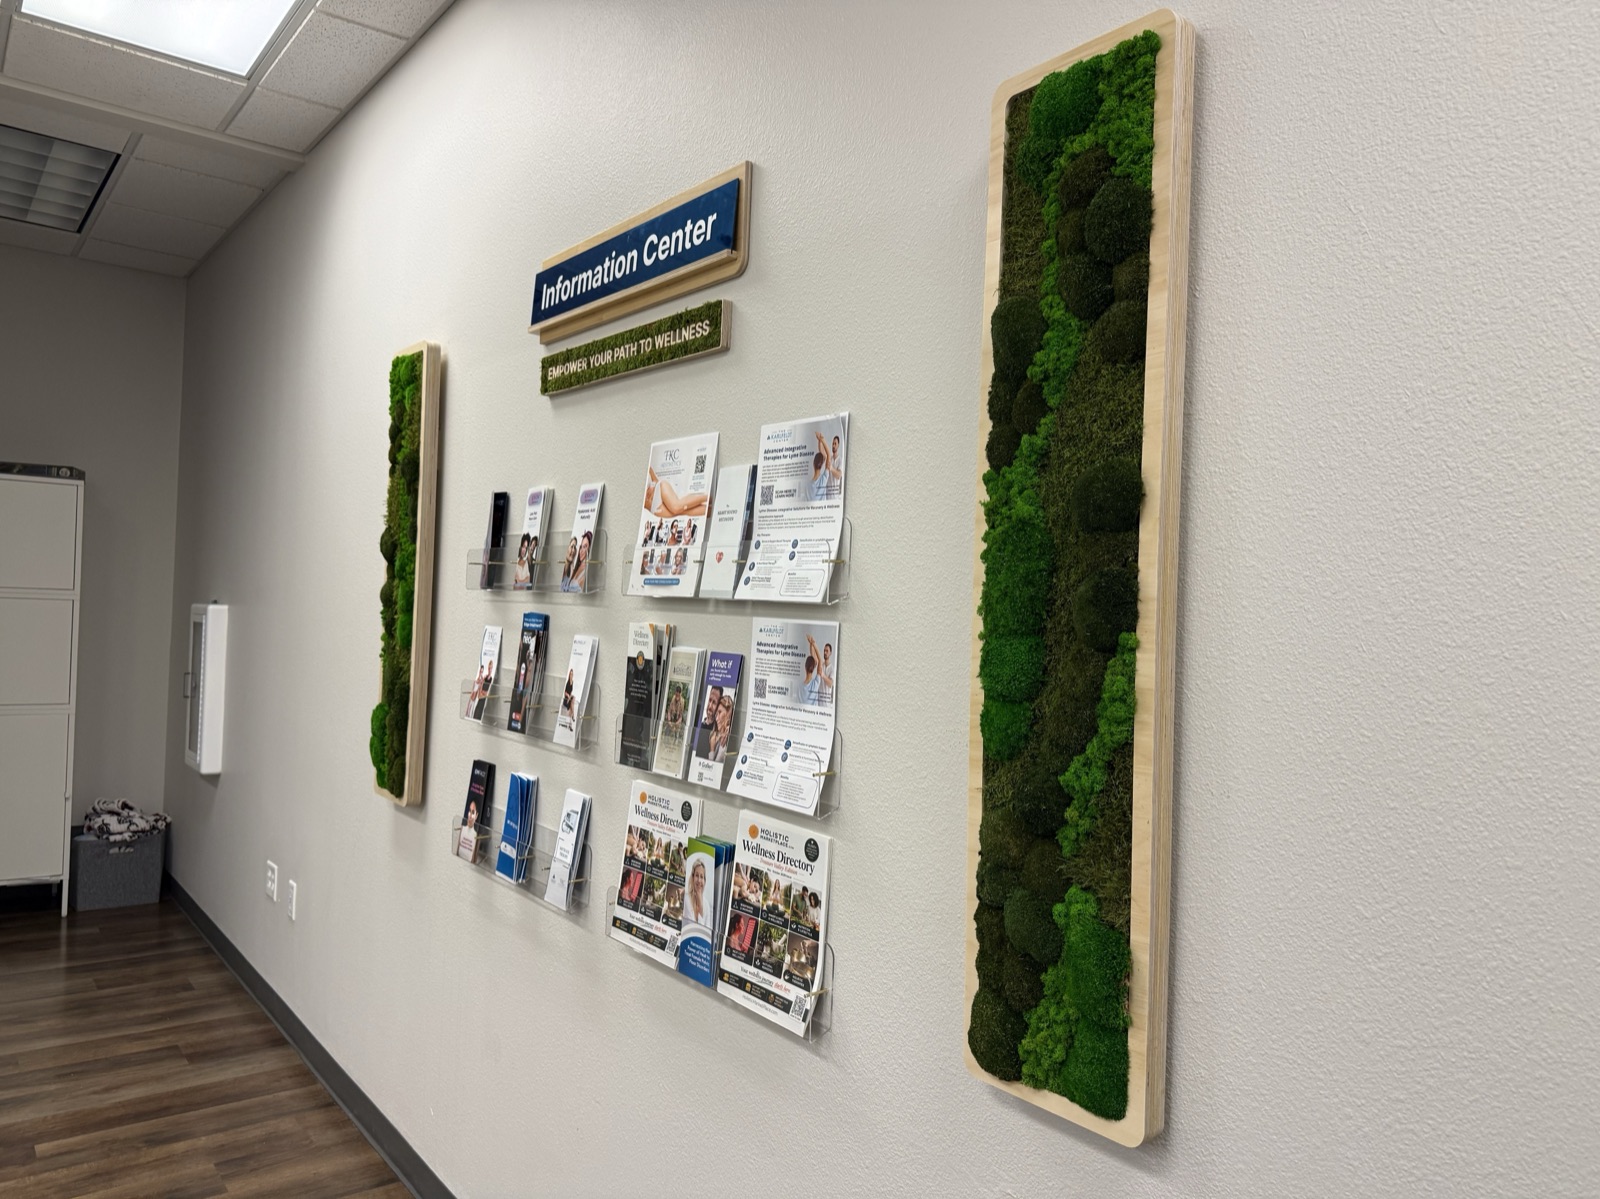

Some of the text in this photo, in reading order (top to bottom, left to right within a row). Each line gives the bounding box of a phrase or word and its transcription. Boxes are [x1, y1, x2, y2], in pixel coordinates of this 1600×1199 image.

[541, 212, 717, 310] Information Center
[548, 320, 710, 380] EMPOWER YOUR PATH TO WELLNESS
[764, 444, 807, 455] Advanced Integrative
[763, 454, 781, 462] Therapies
[712, 659, 733, 669] What if
[648, 794, 670, 806] HOLISTIC
[635, 804, 659, 822] Wellness
[660, 813, 688, 833] Directory
[760, 827, 789, 843] HOLISTIC
[742, 839, 775, 861] Wellness
[777, 850, 815, 877] Directory
